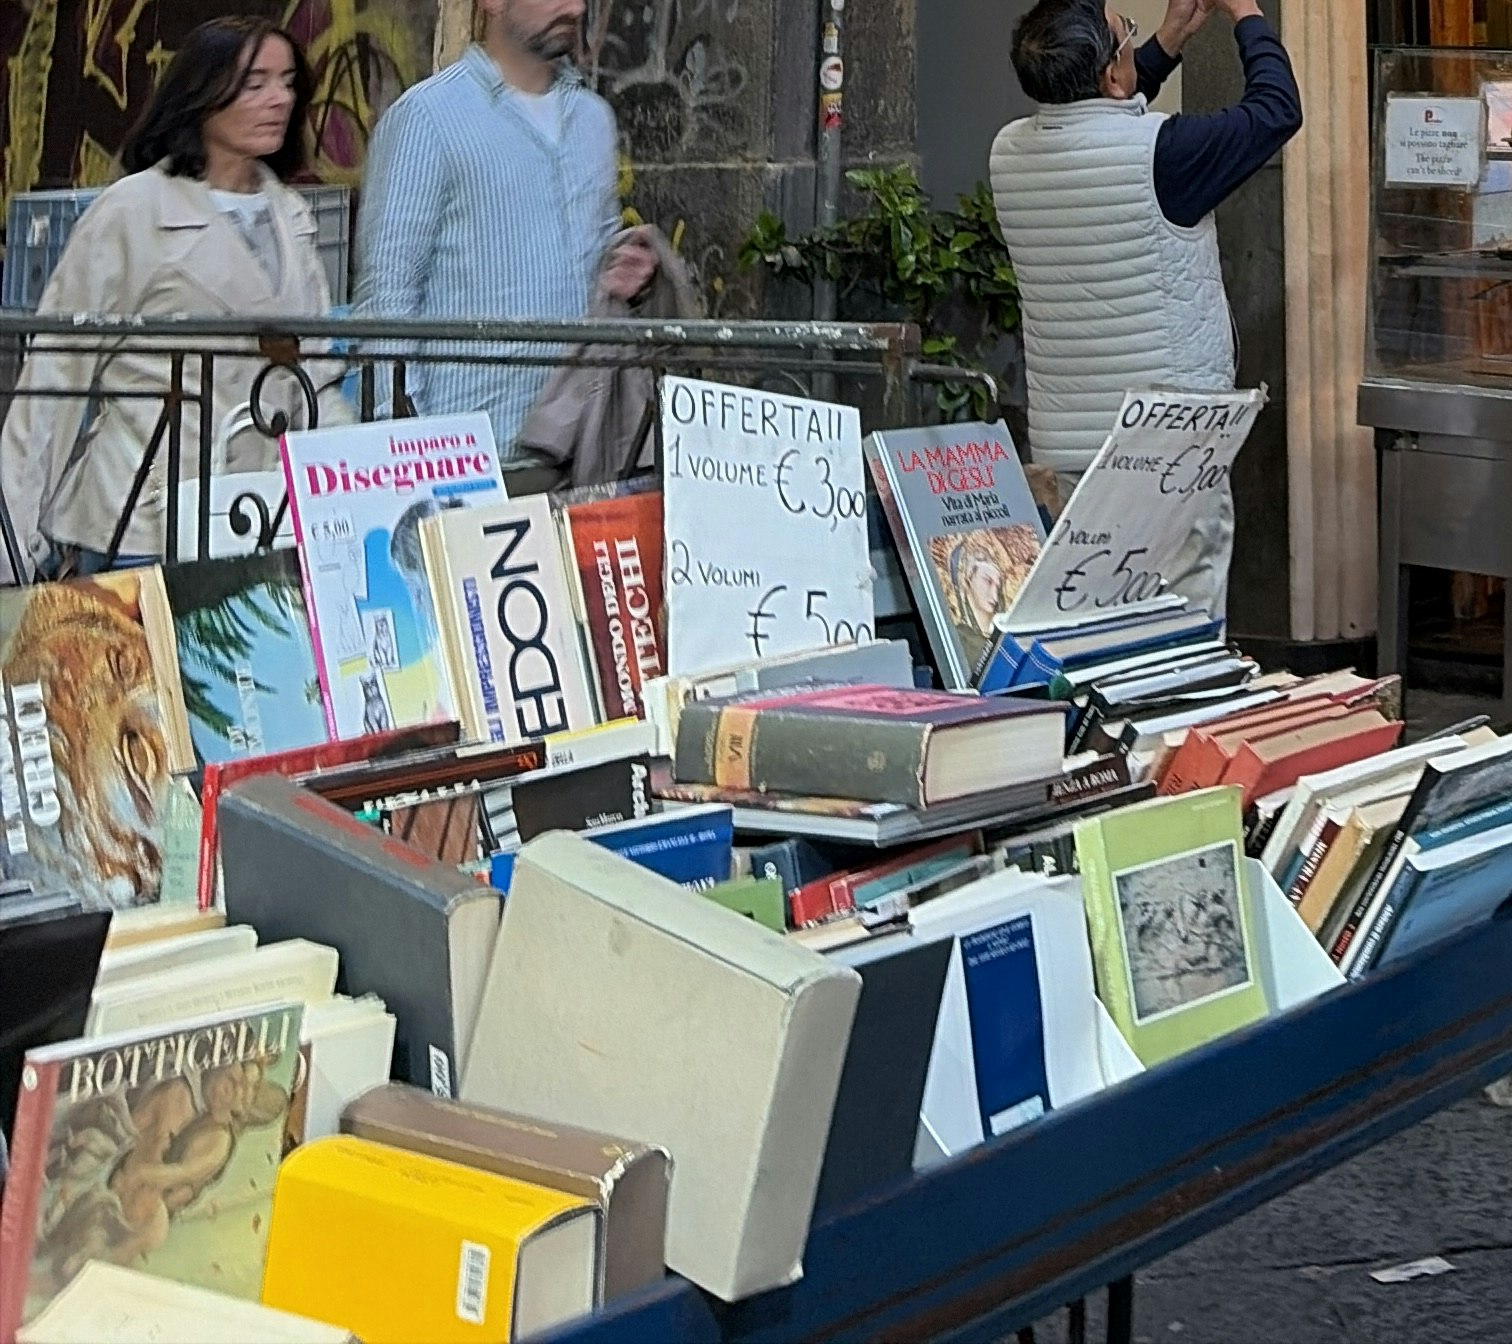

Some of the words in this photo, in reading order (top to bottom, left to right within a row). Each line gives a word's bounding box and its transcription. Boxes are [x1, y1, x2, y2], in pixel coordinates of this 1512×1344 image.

[389, 435, 461, 457] imparo
[463, 433, 477, 448] a
[668, 434, 684, 479] 1
[688, 455, 767, 488] VOLUME
[923, 439, 1009, 470] MAMMA
[304, 449, 491, 498] Disegnare
[591, 538, 619, 613] DEGLI
[671, 540, 694, 586] 2
[697, 560, 761, 588] VOLUMI
[462, 576, 502, 715] IMPRESSIONISTI
[11, 680, 61, 827] GRECI
[69, 1013, 290, 1104] BOTTICELLI
